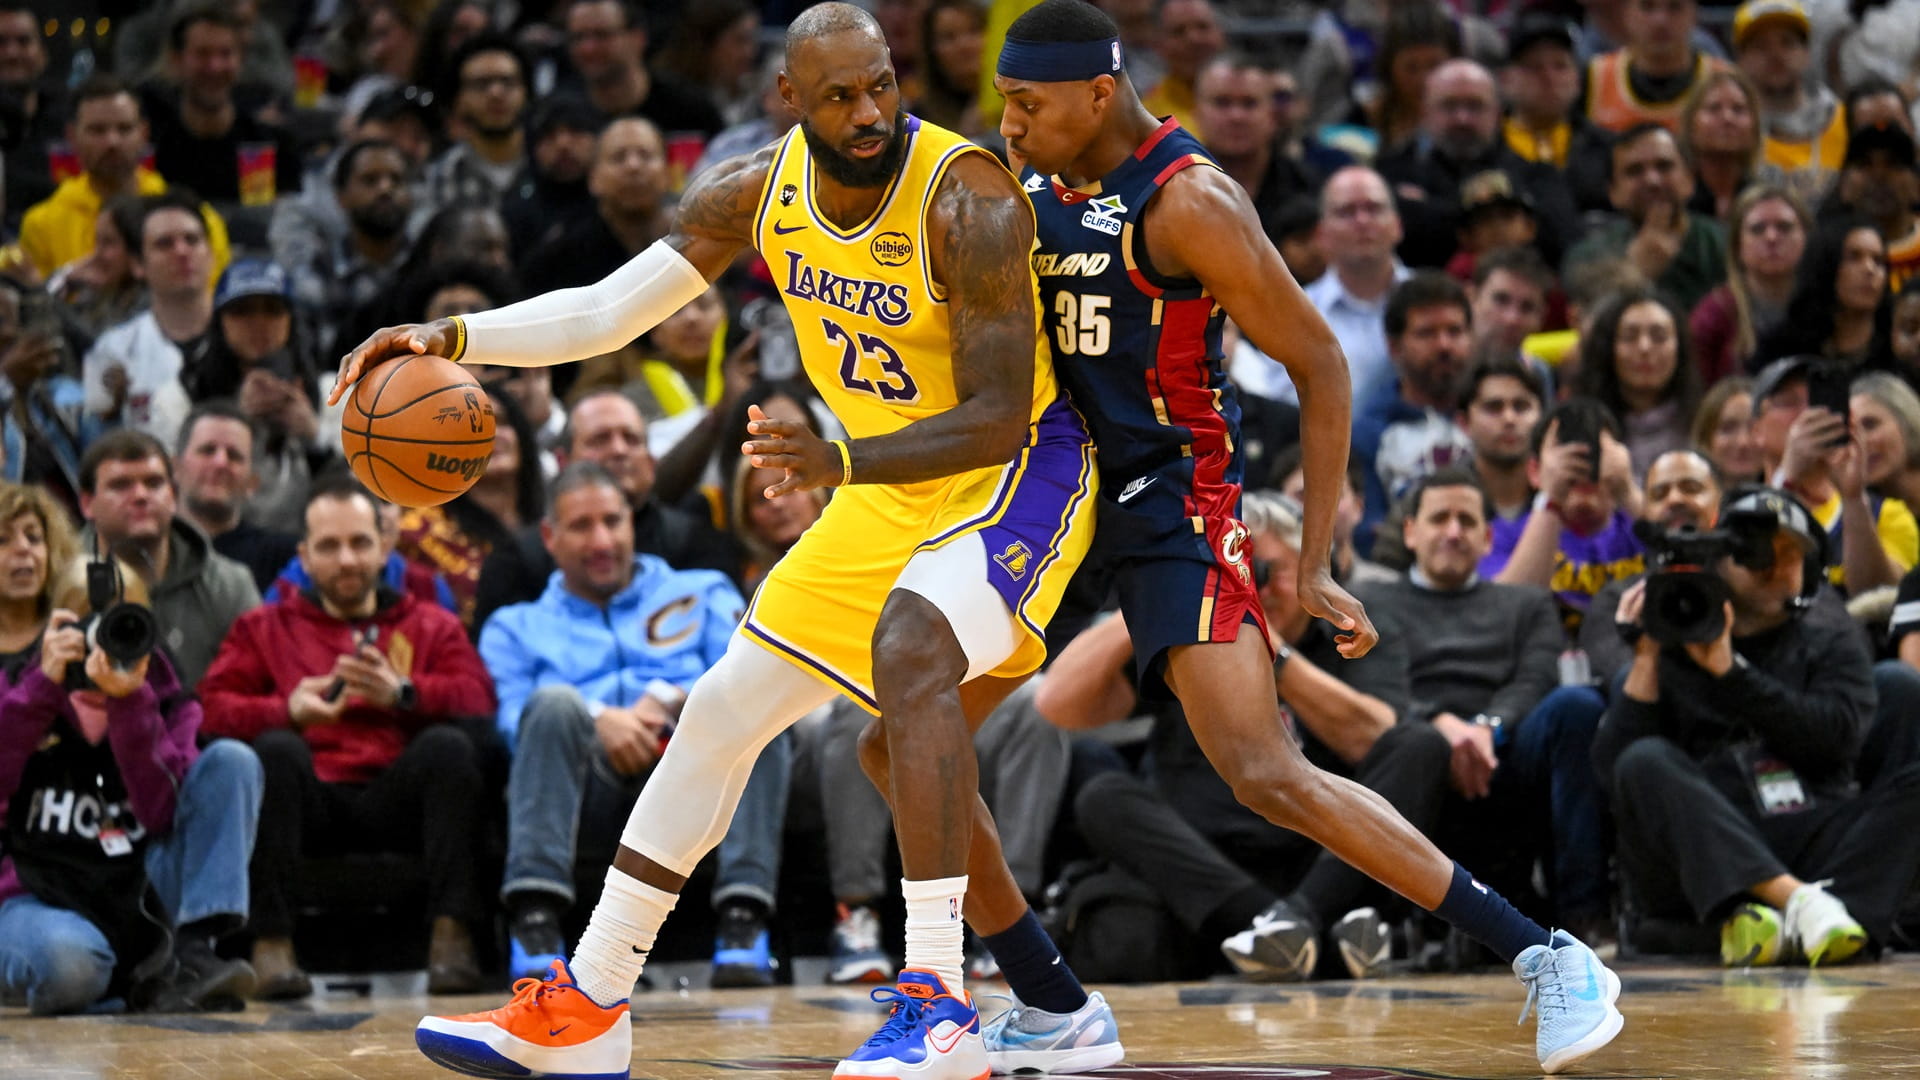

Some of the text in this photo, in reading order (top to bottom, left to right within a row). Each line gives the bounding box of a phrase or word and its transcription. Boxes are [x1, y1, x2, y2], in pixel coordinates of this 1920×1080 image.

[875, 240, 911, 257] bibigo
[1083, 214, 1120, 232] CLIFFS
[784, 250, 912, 327] LAKERS
[1054, 289, 1111, 357] 35
[821, 317, 921, 405] 23
[1122, 476, 1148, 494] NIKE
[646, 594, 698, 647] C
[26, 788, 146, 841] PHO
